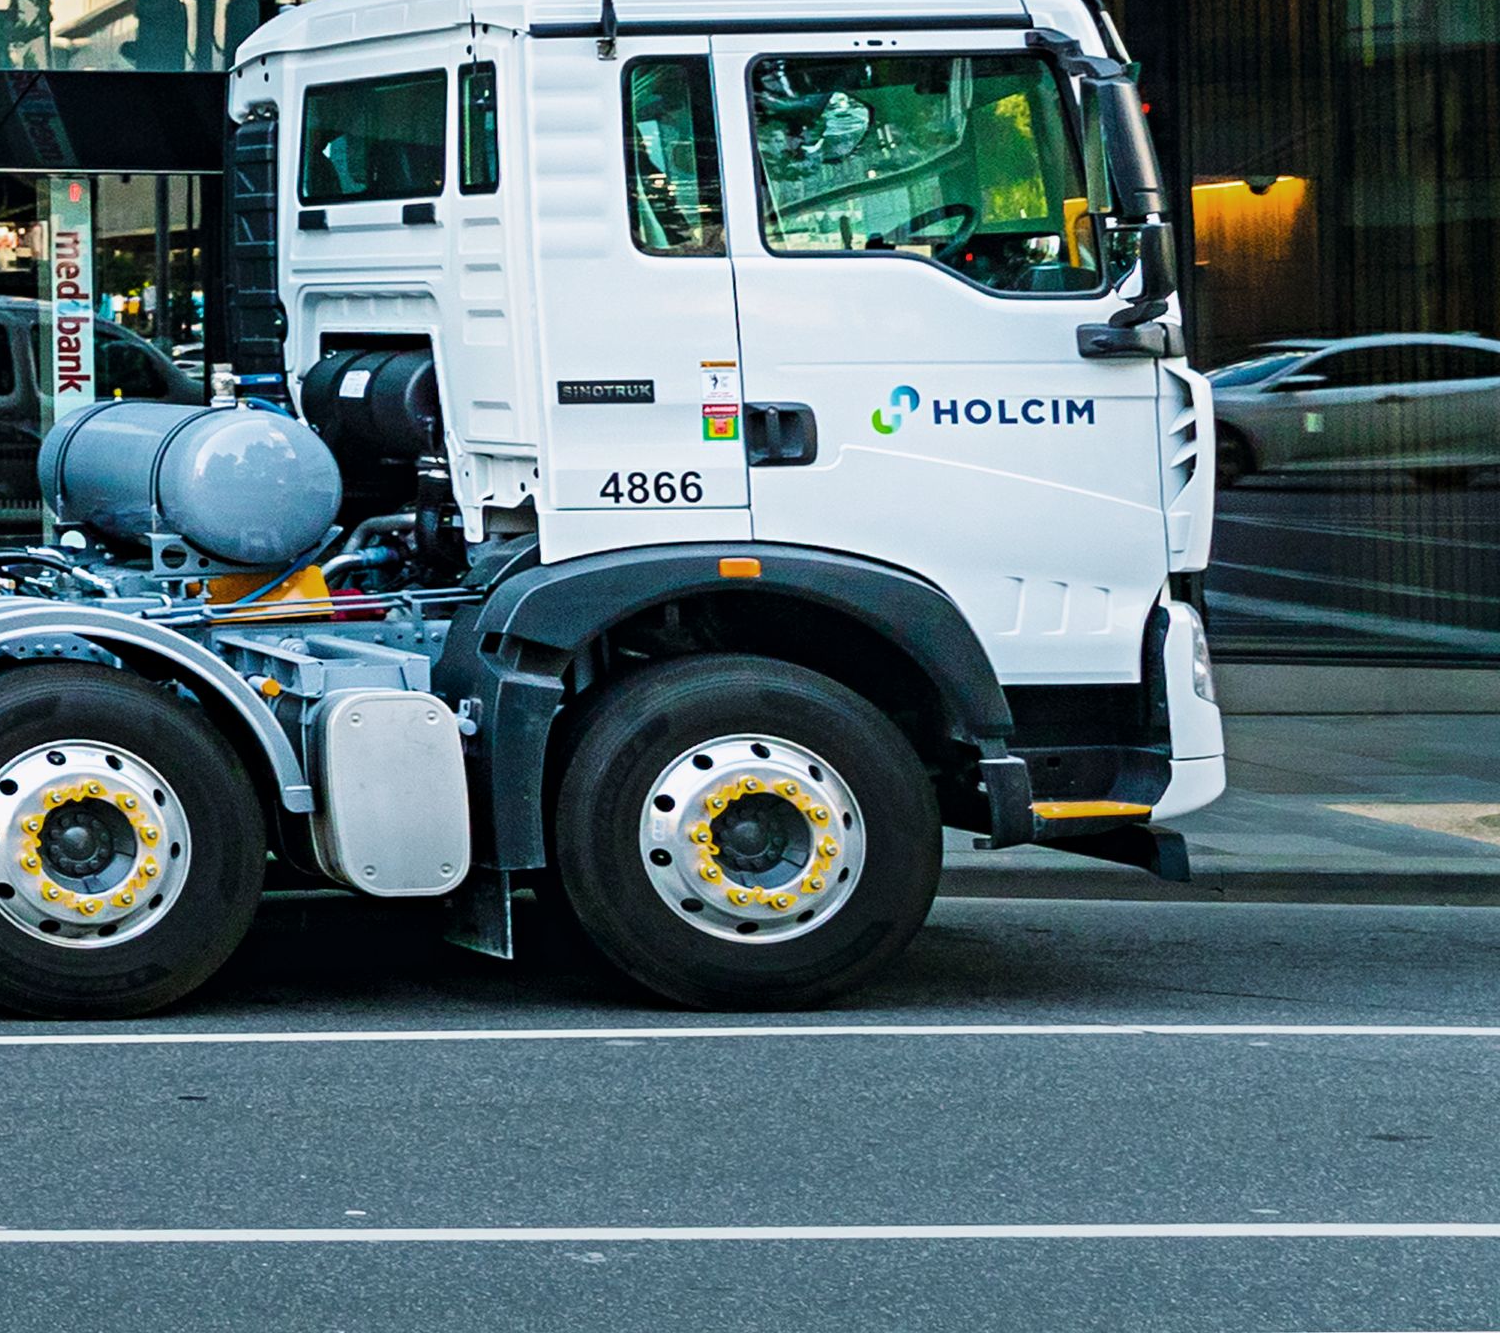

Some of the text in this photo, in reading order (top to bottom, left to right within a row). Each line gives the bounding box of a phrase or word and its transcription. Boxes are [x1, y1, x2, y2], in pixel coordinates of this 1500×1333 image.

[55, 231, 92, 394] medibank
[561, 384, 652, 398] SINOTRUK
[933, 399, 1095, 425] HOLCIM
[599, 471, 703, 504] 4866
